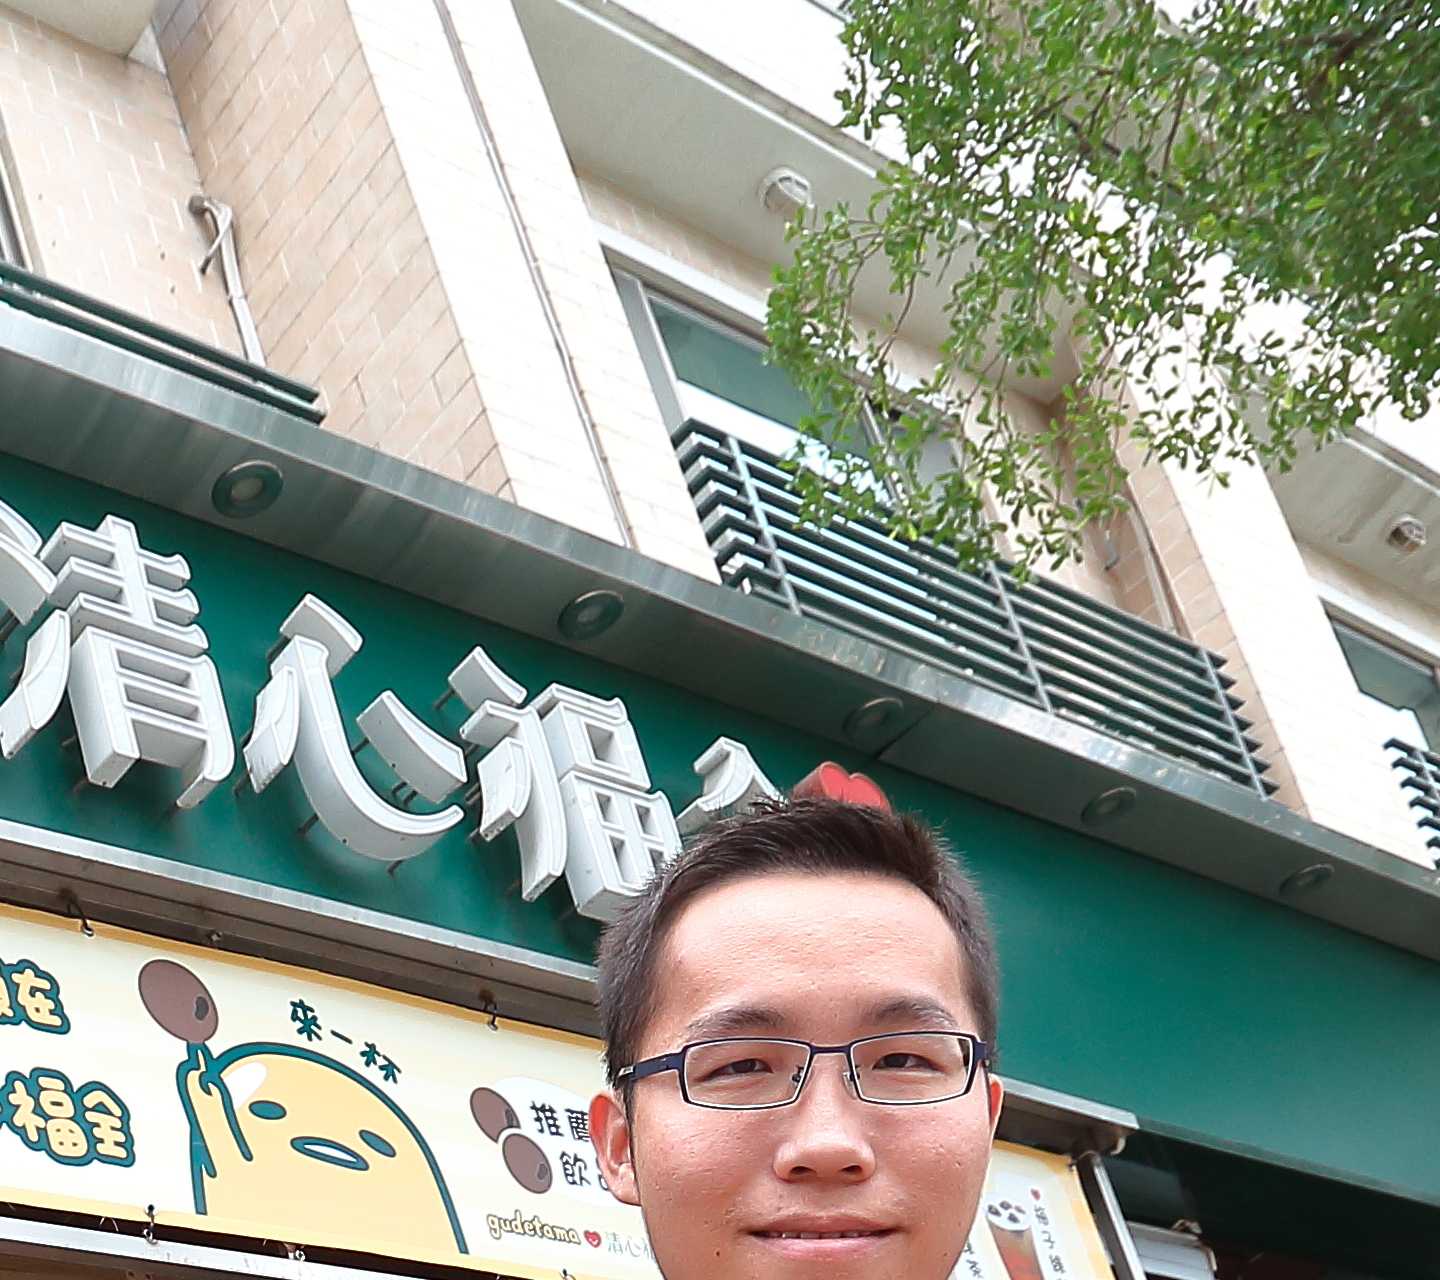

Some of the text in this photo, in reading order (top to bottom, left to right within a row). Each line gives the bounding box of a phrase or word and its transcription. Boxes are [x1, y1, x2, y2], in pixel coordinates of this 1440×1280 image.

[289, 999, 402, 1085] 來一杯
[559, 1151, 610, 1192] 飲
[487, 1209, 581, 1245] gudetama
